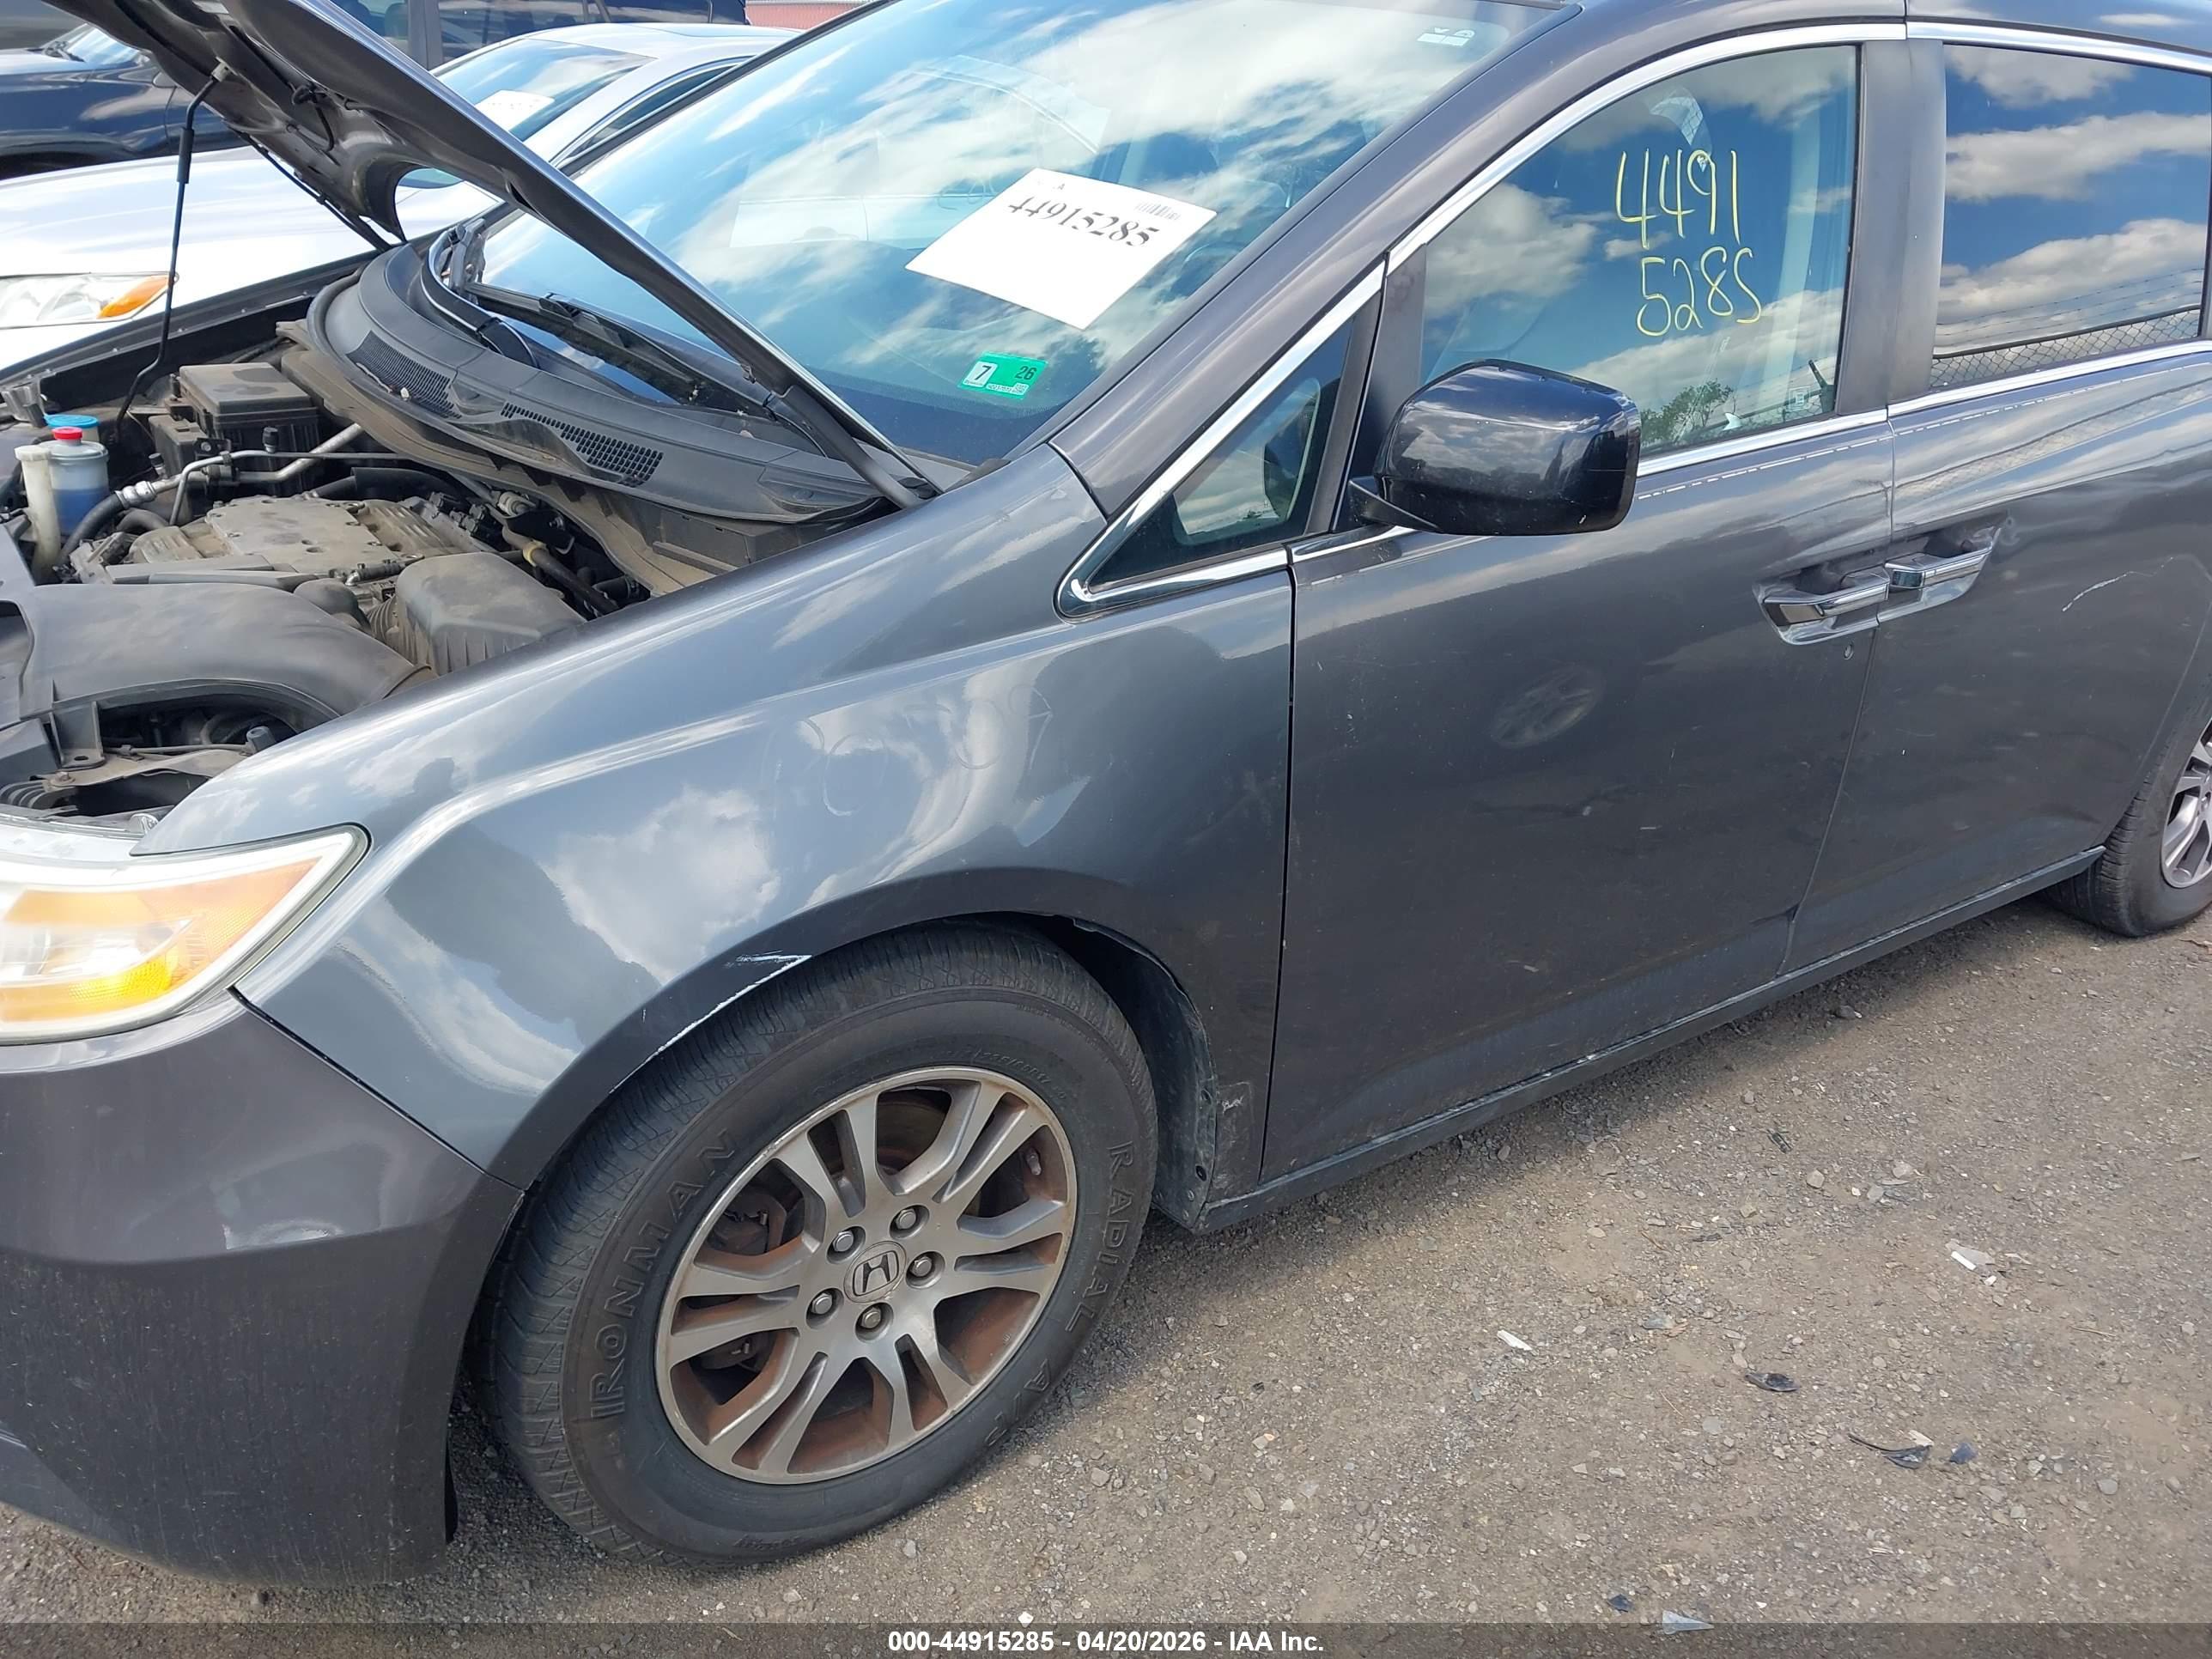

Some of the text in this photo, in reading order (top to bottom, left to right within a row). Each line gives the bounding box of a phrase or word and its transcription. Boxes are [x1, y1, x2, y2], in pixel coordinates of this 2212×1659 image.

[1008, 197, 1159, 246] 44915285
[1615, 148, 1741, 250] 4491
[975, 364, 1037, 380] 7 26
[590, 1128, 737, 1419] IRONMAN
[1065, 1139, 1135, 1332] RADIAL
